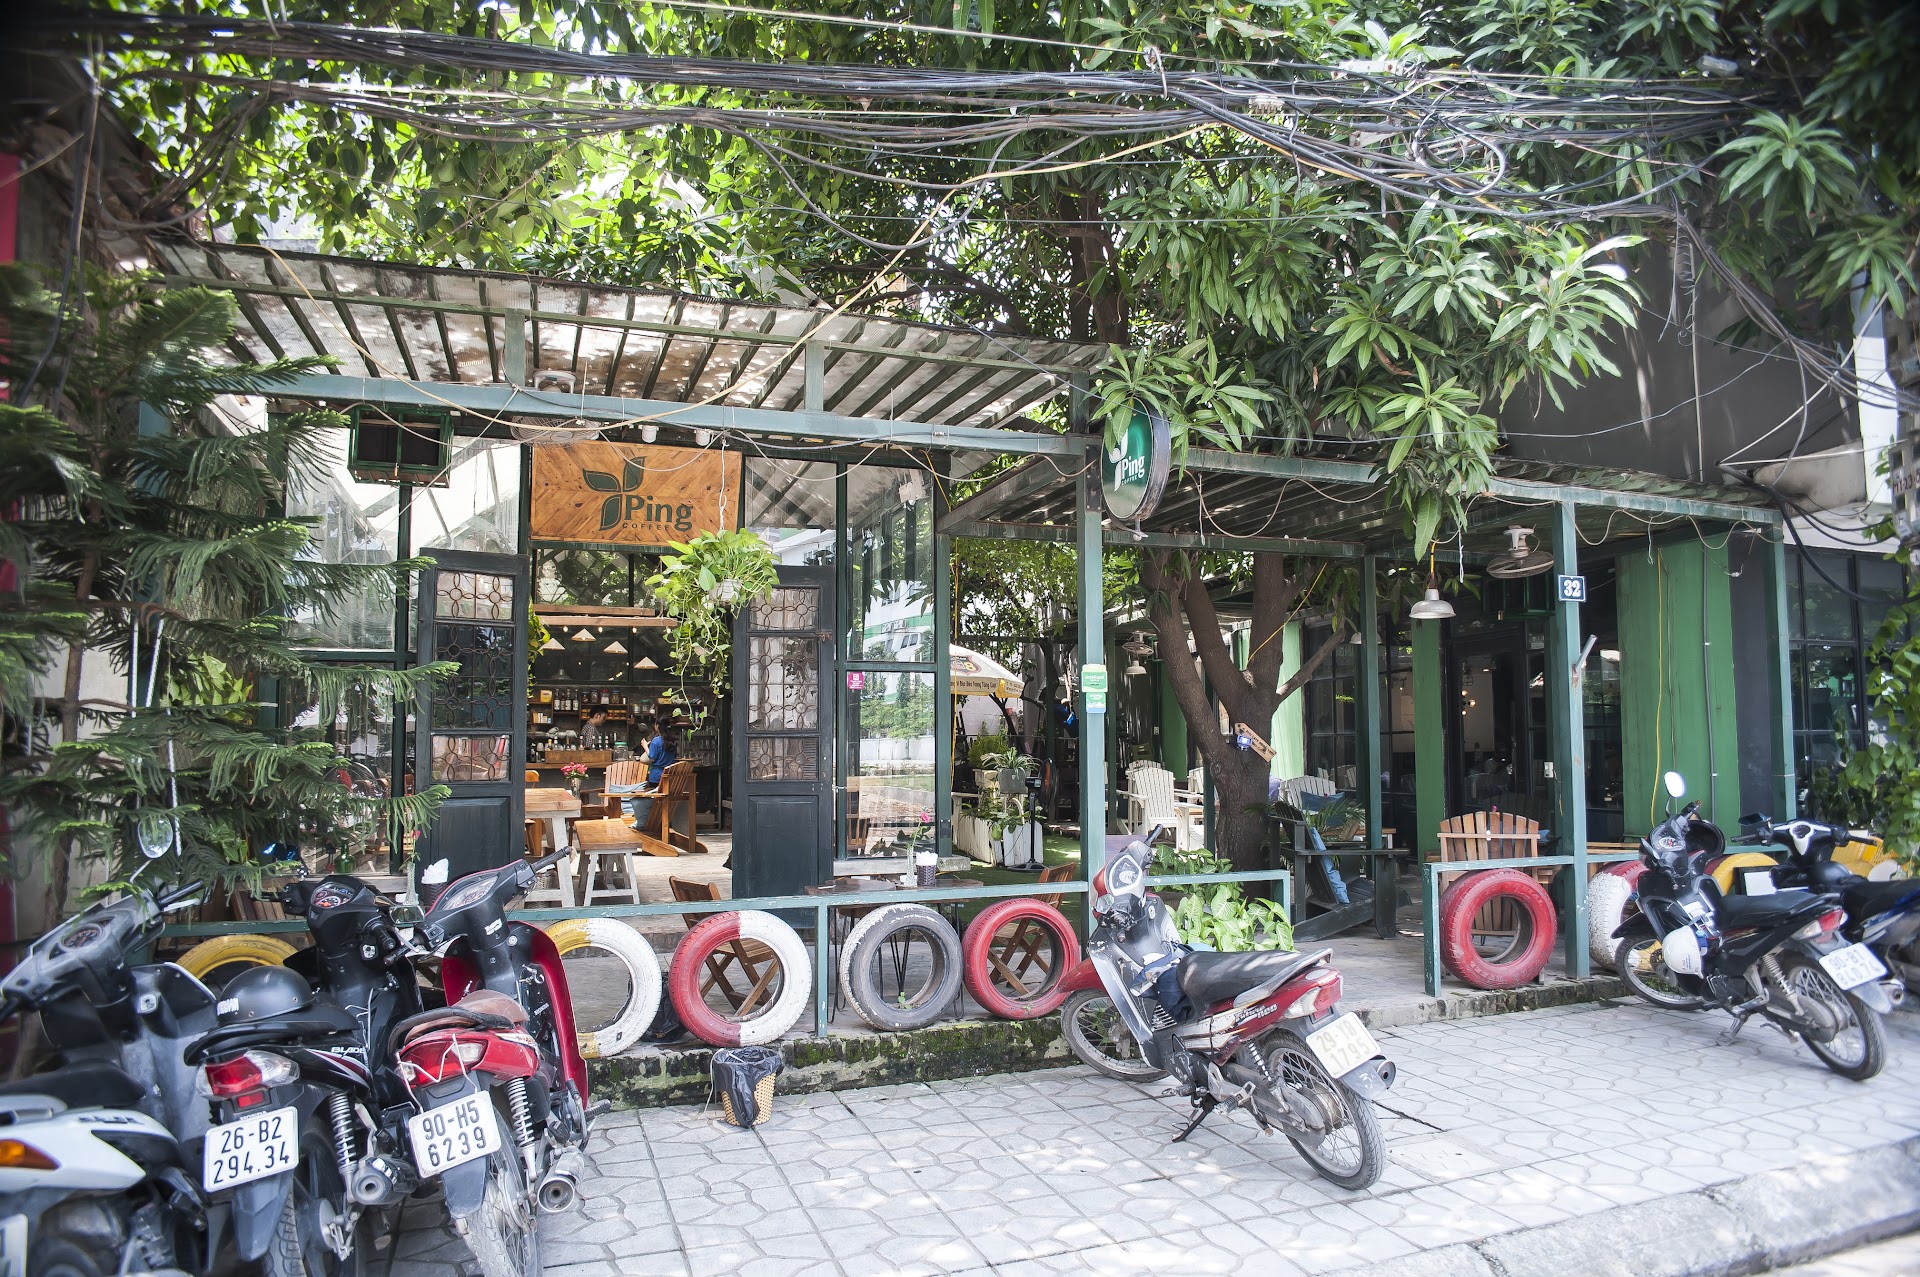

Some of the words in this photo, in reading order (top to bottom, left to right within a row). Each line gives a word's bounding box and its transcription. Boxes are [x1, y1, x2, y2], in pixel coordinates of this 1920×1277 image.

[1121, 455, 1145, 479] Ping
[1121, 475, 1138, 486] COFFEE
[622, 522, 669, 531] COFFEE
[624, 495, 693, 532] Ping
[1563, 579, 1581, 597] 32
[331, 1046, 365, 1056] BLADE
[1330, 1037, 1370, 1070] 1795
[221, 1116, 282, 1154] 26-B2
[422, 1100, 480, 1140] 90-H5
[213, 1141, 289, 1185] 294.34
[427, 1126, 487, 1167] 6239
